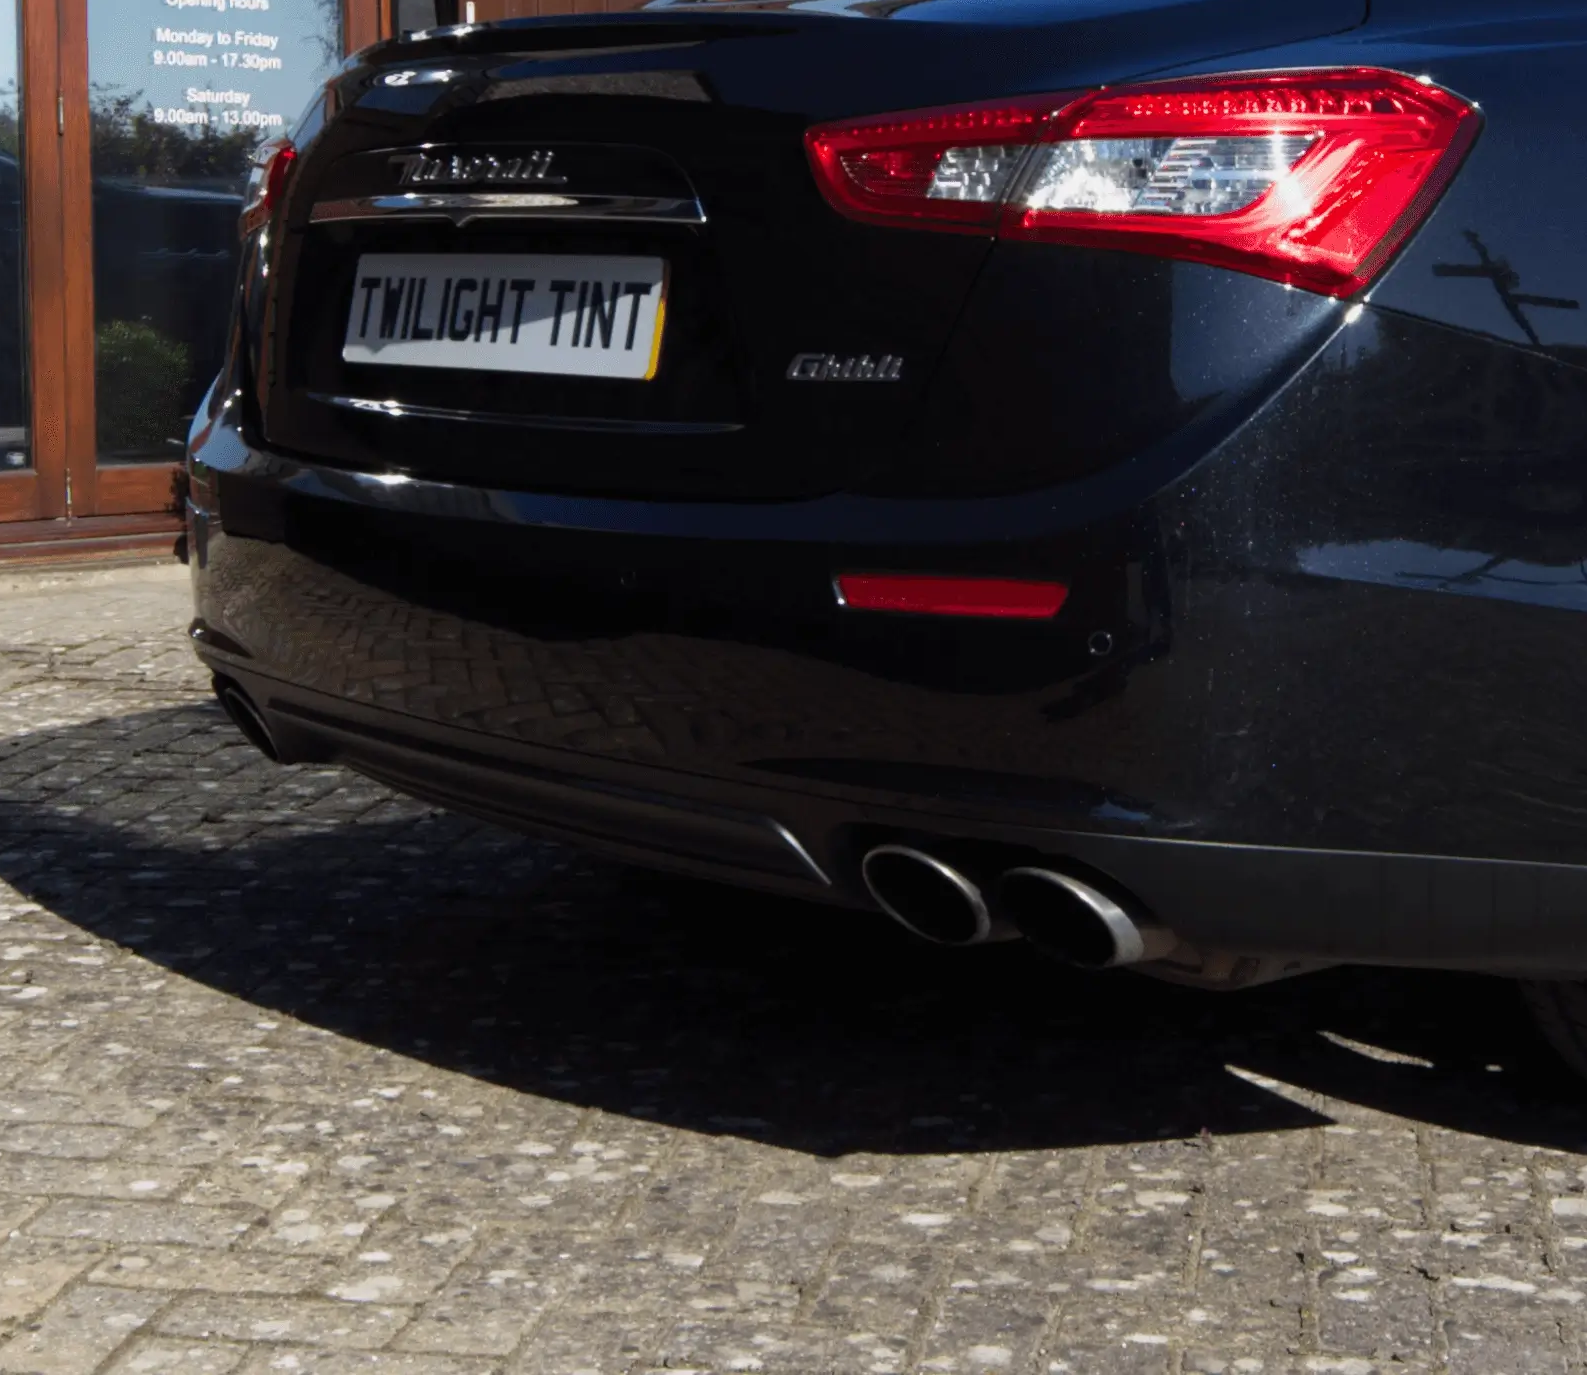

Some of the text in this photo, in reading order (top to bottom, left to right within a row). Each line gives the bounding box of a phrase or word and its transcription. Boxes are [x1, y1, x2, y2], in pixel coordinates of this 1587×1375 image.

[155, 27, 279, 51] Monday to Friday
[153, 49, 208, 67] 9.00am
[221, 52, 282, 72] 17.30pm
[186, 87, 251, 108] Saturday
[153, 107, 209, 125] 9.00am
[222, 110, 283, 129] 13.00pm
[358, 277, 653, 352] TWILIGHT TINT
[786, 352, 904, 382] Ghibli
